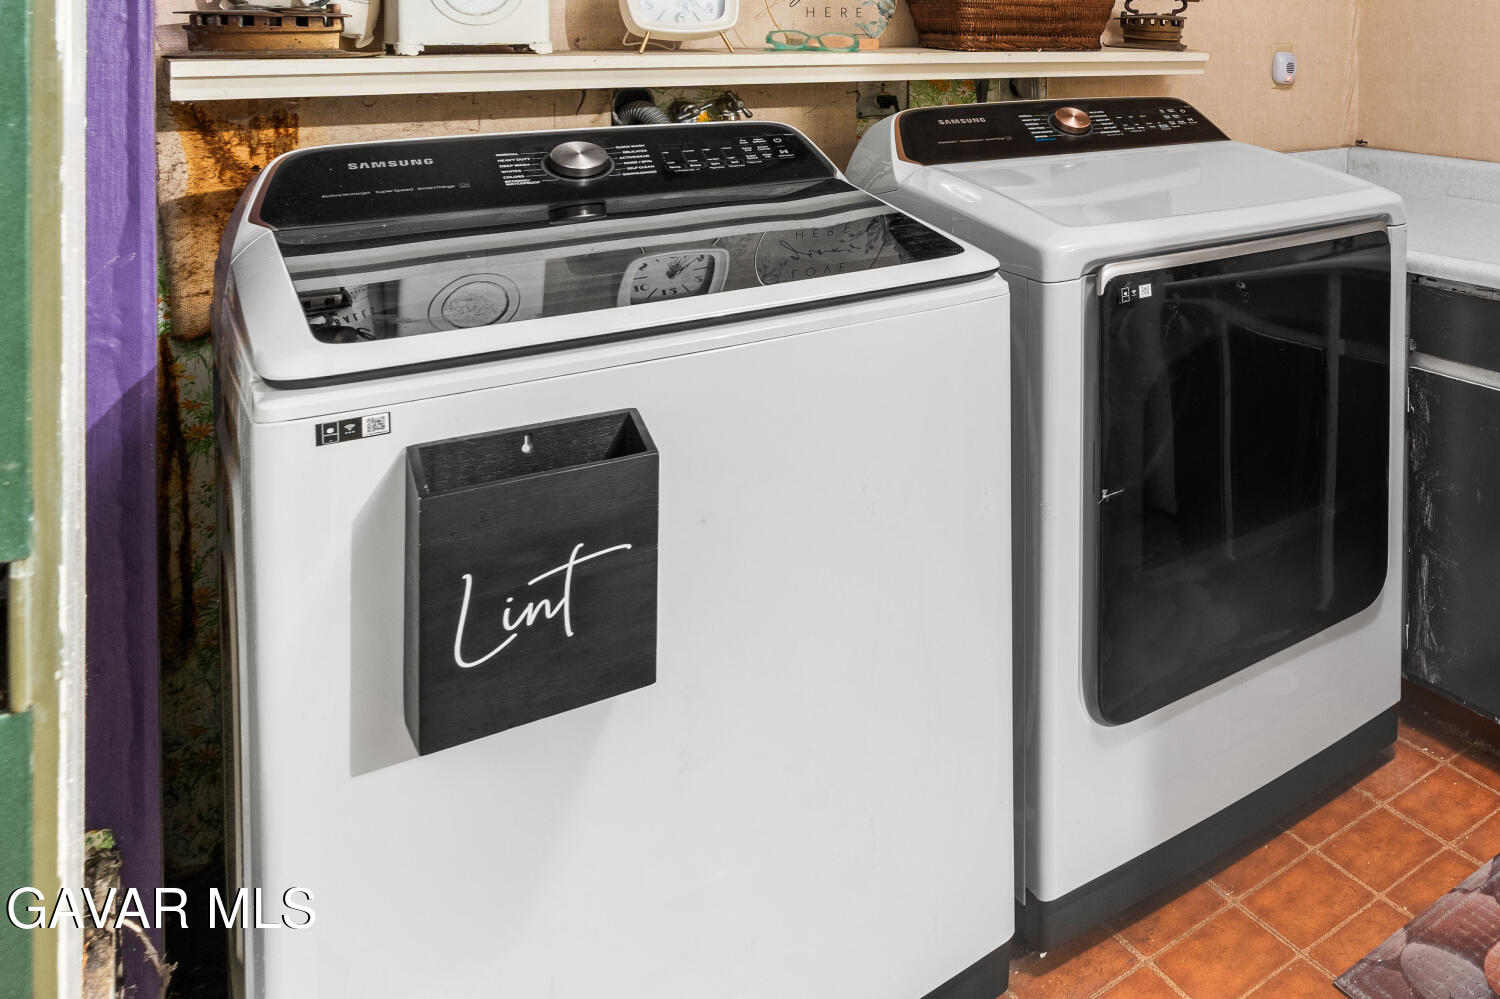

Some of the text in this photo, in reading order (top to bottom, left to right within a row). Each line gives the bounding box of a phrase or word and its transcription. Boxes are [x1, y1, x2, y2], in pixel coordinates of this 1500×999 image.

[805, 6, 863, 18] HERE
[938, 117, 987, 126] SAMSUNG
[347, 157, 434, 170] SAMSUNG
[454, 542, 632, 669] Lint
